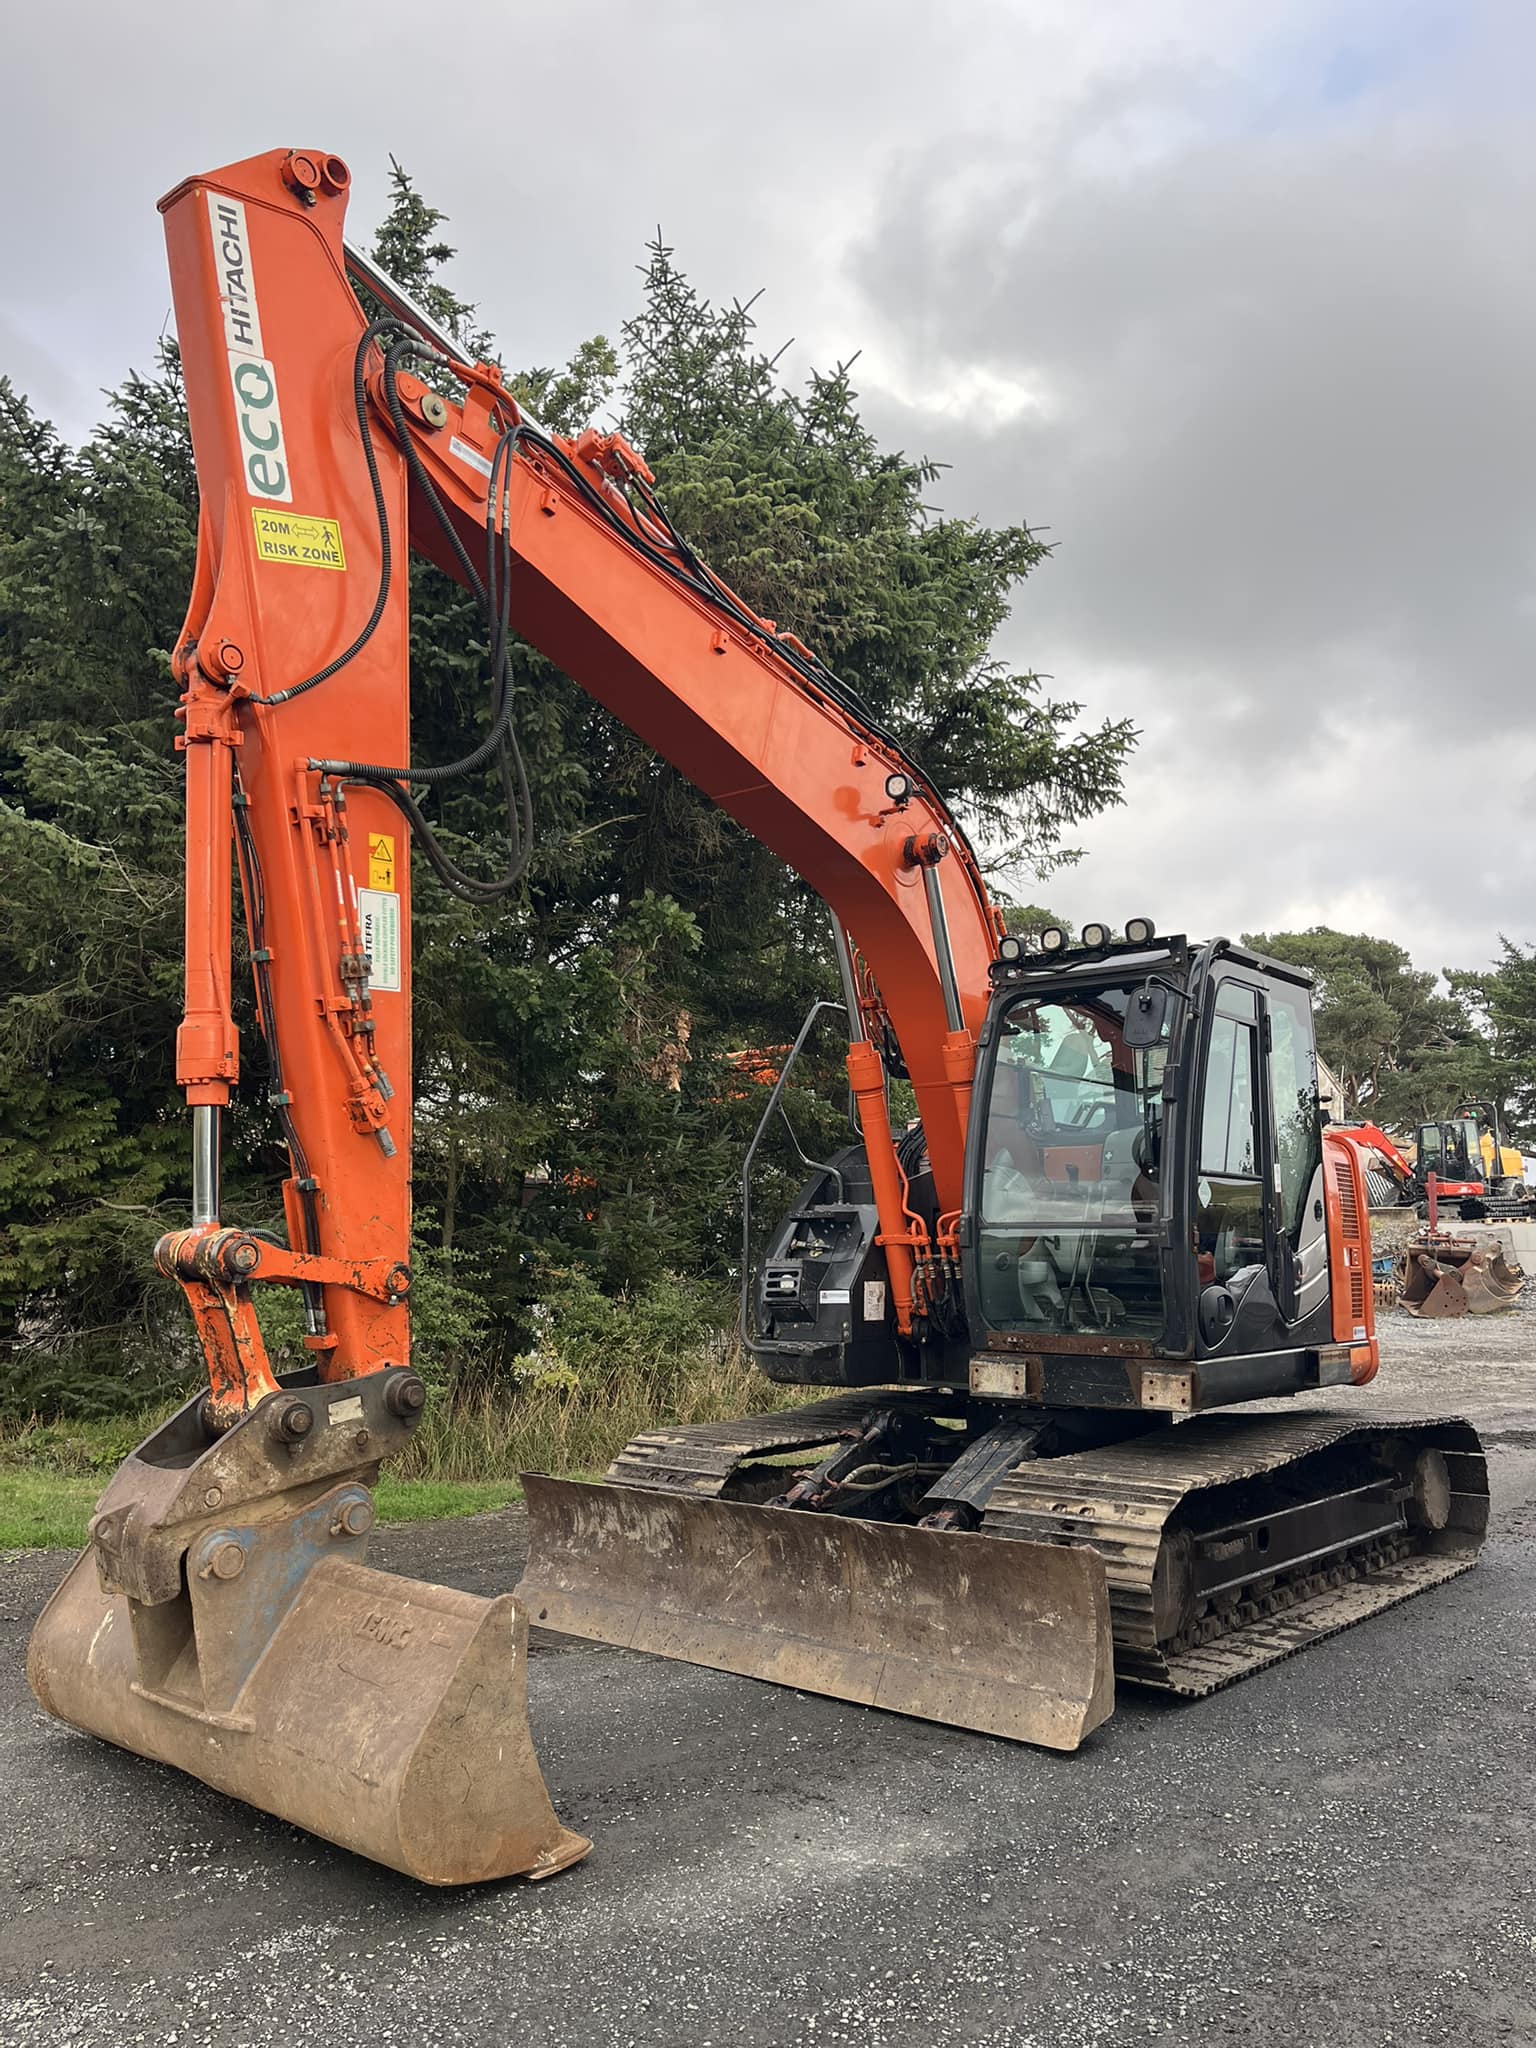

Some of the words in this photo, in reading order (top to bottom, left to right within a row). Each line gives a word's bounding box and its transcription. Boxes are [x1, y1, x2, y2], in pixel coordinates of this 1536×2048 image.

[217, 203, 253, 346] HITACHI
[261, 519, 290, 535] 20M
[263, 541, 298, 557] RISK
[302, 546, 340, 563] ZONE
[365, 913, 373, 951] TEFRA
